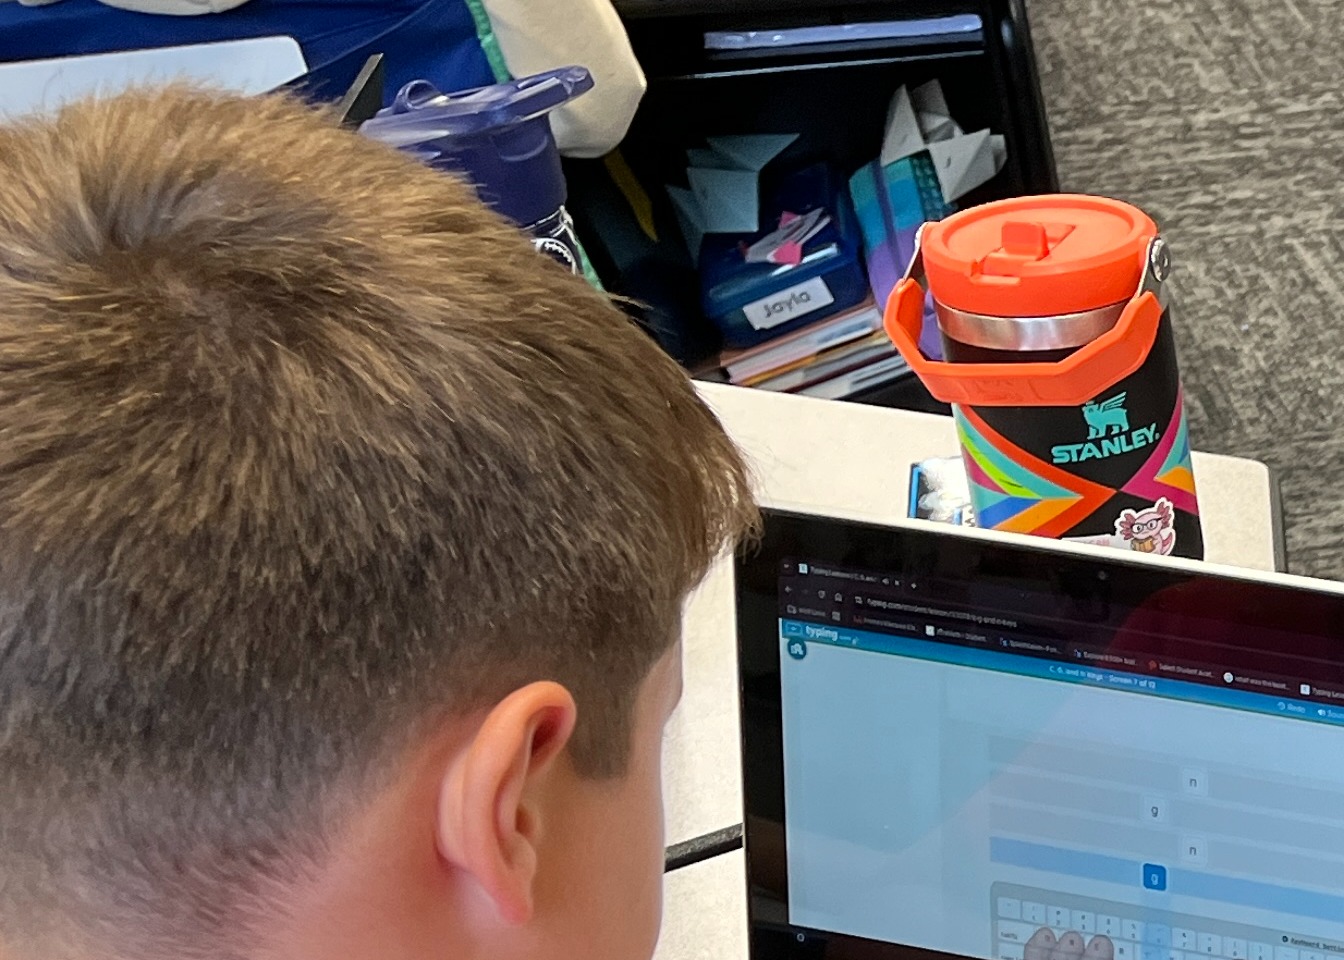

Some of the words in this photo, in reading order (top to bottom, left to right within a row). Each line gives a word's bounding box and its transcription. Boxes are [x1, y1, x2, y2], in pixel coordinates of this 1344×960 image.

[805, 625, 838, 642] typing
[1109, 674, 1133, 685] Screen
[1189, 778, 1198, 787] n
[1150, 806, 1159, 818] g
[1189, 847, 1197, 856] n
[1150, 873, 1159, 886] g
